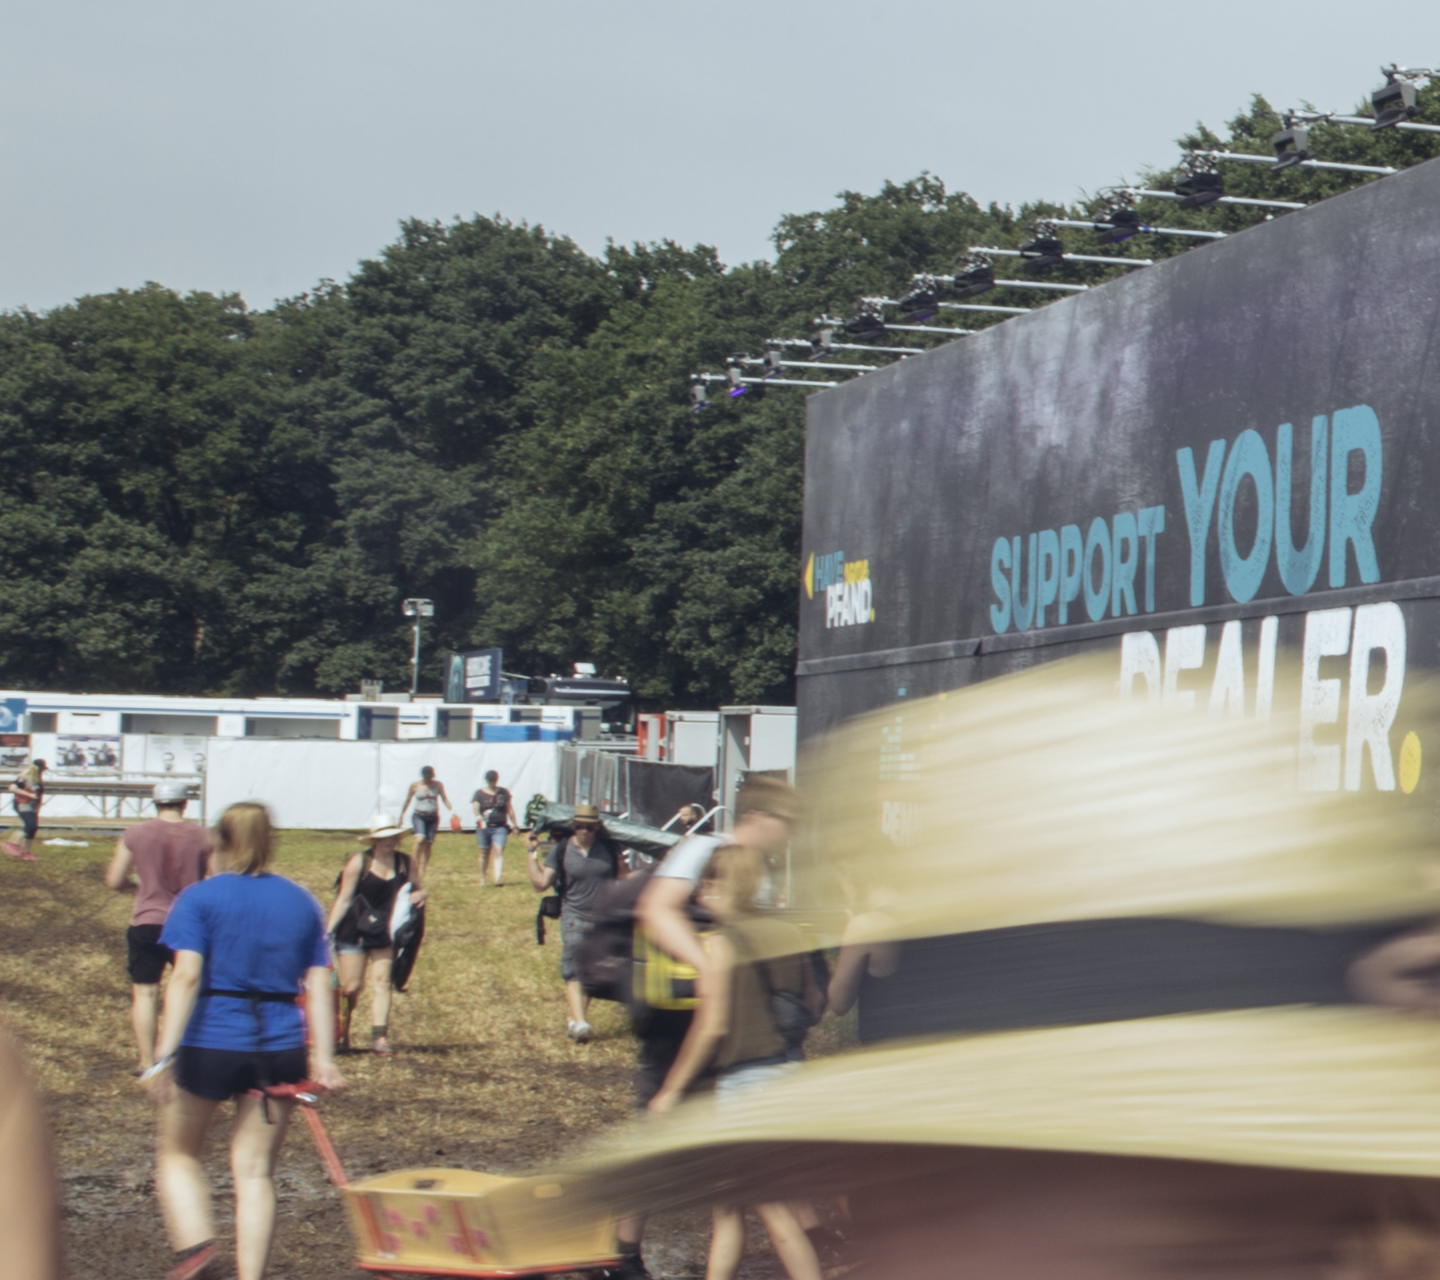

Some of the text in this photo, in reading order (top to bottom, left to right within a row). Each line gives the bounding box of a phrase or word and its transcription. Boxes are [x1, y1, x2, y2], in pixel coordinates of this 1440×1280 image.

[989, 403, 1384, 635] SUPPORT YOUR
[815, 551, 844, 592] HAVE
[826, 578, 876, 629] PFAND.
